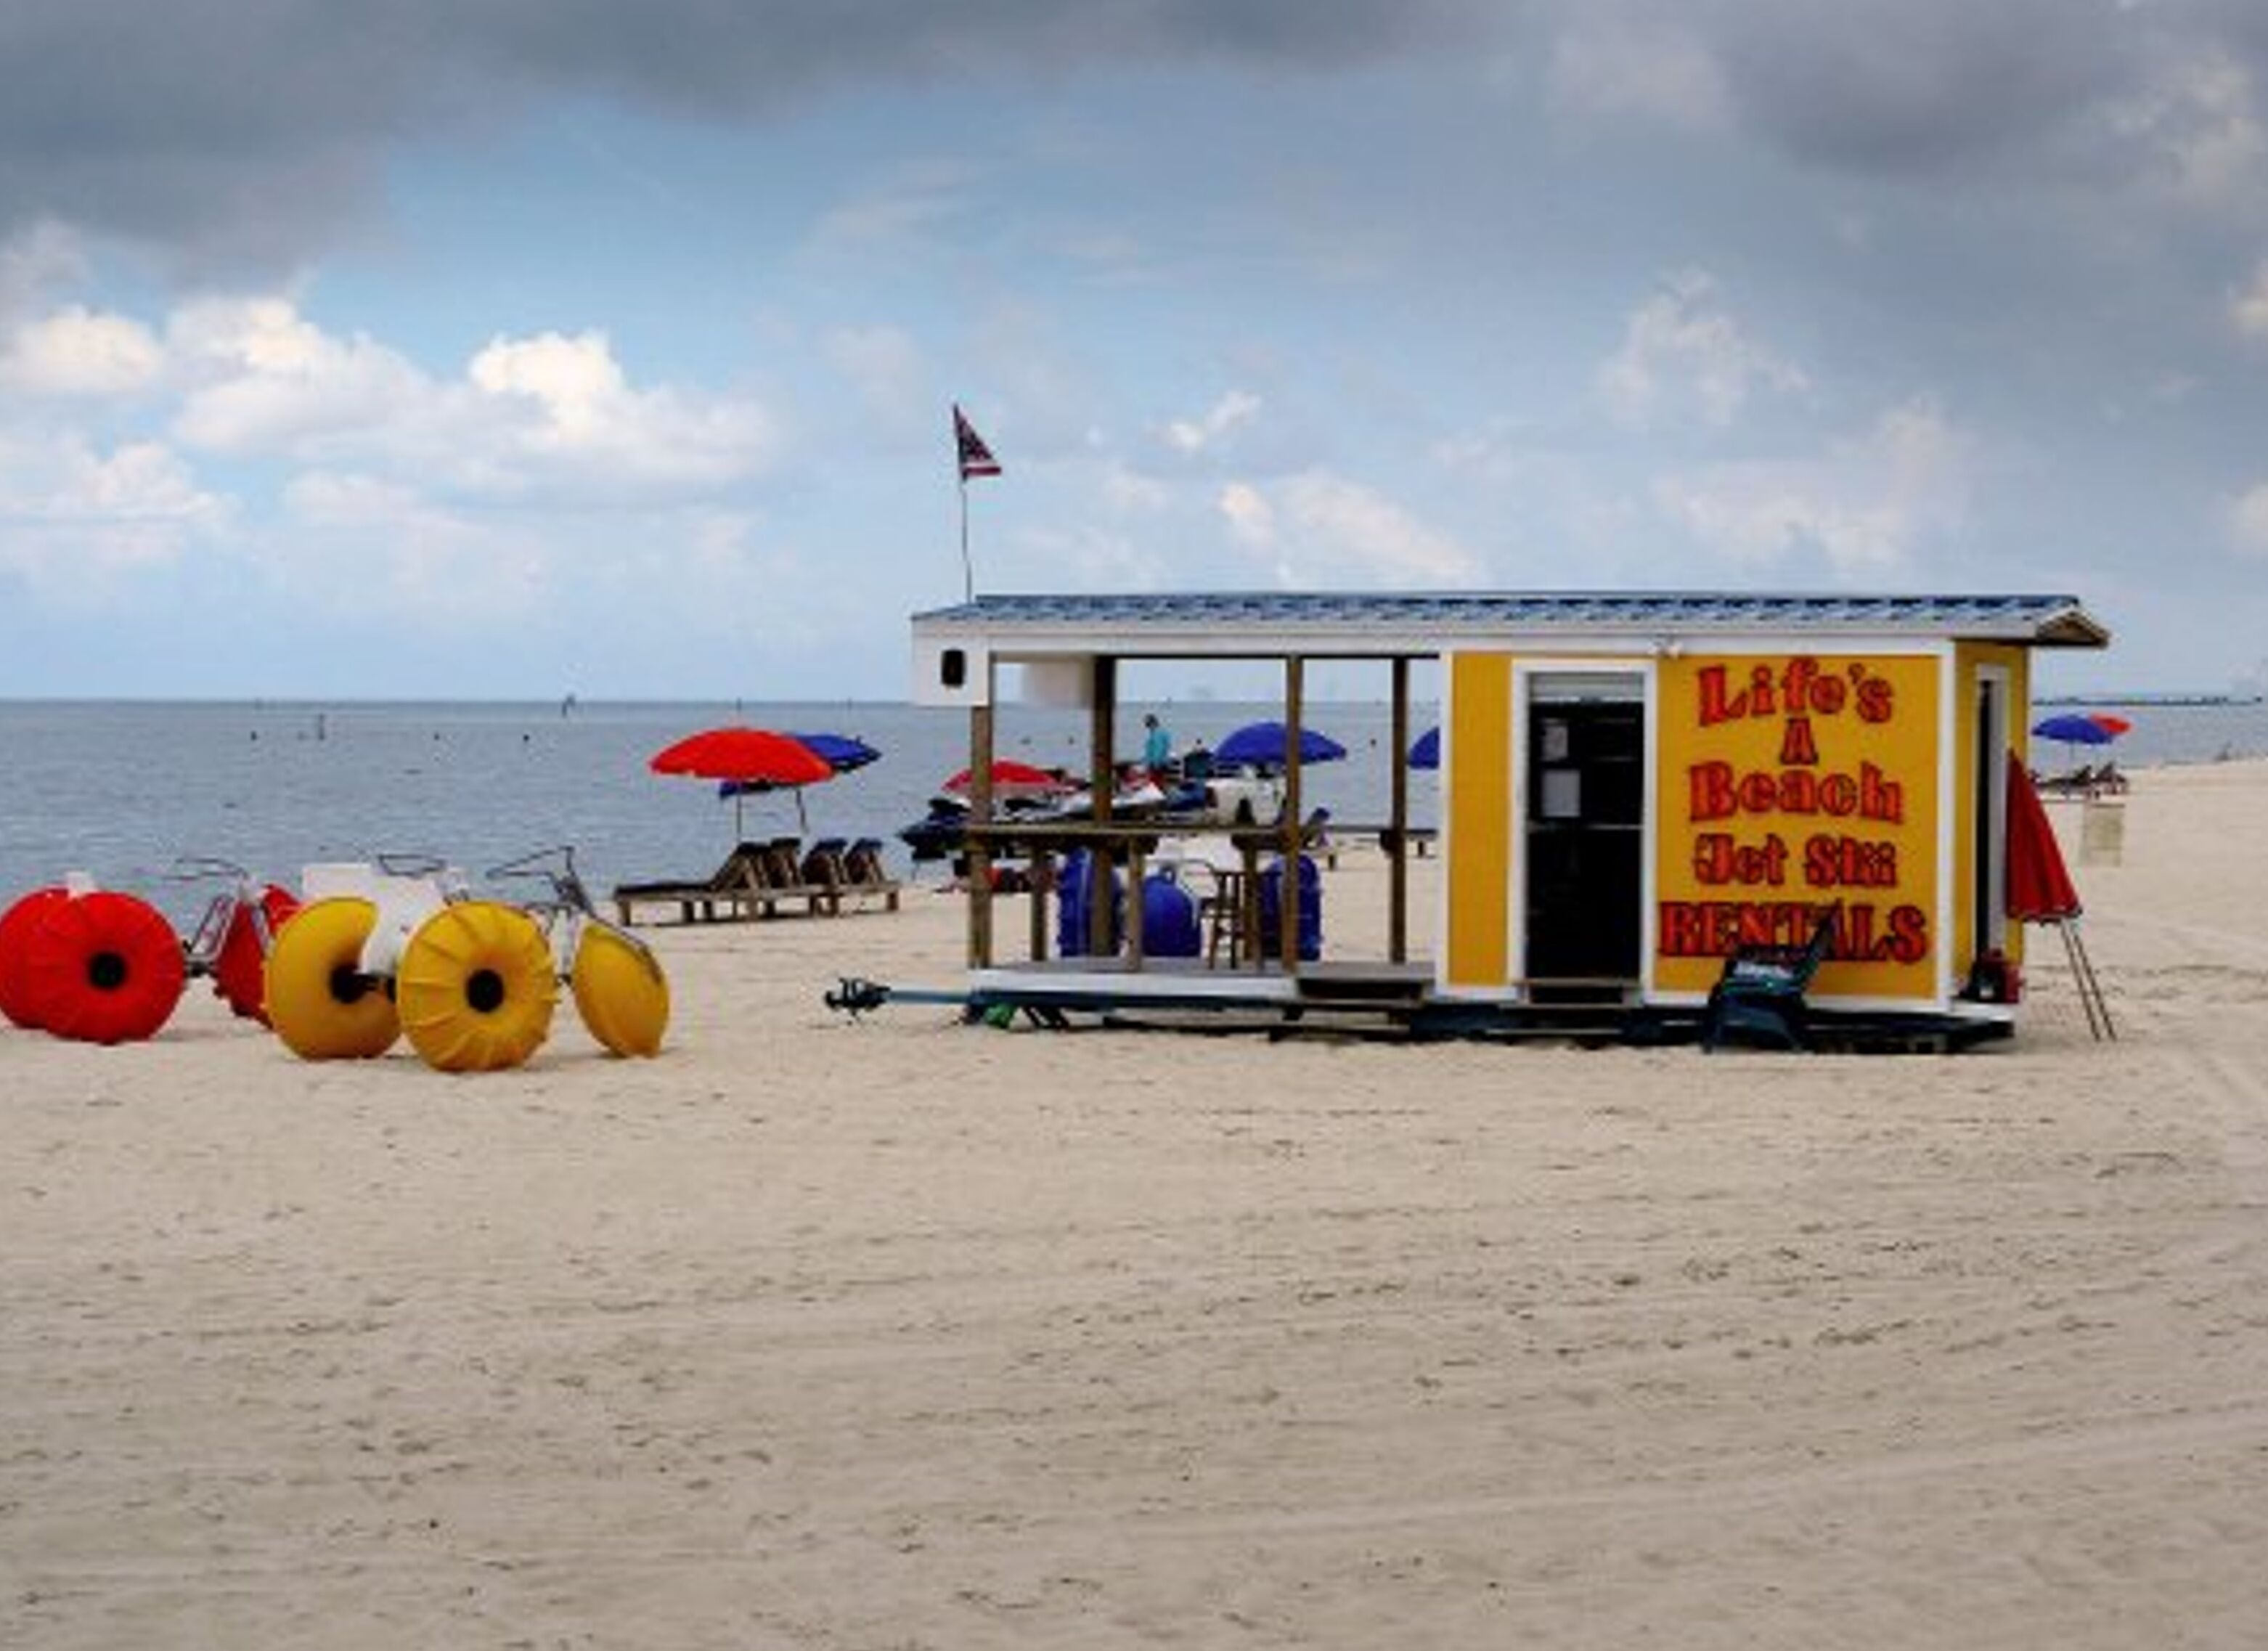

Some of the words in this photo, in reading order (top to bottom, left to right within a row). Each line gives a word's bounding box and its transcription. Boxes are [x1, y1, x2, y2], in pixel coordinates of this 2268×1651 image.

[1697, 656, 1893, 727] Life's
[1779, 717, 1819, 765] A
[1689, 760, 1905, 825] Beach
[1693, 833, 1789, 886] Jet
[1803, 832, 1898, 888] Ski
